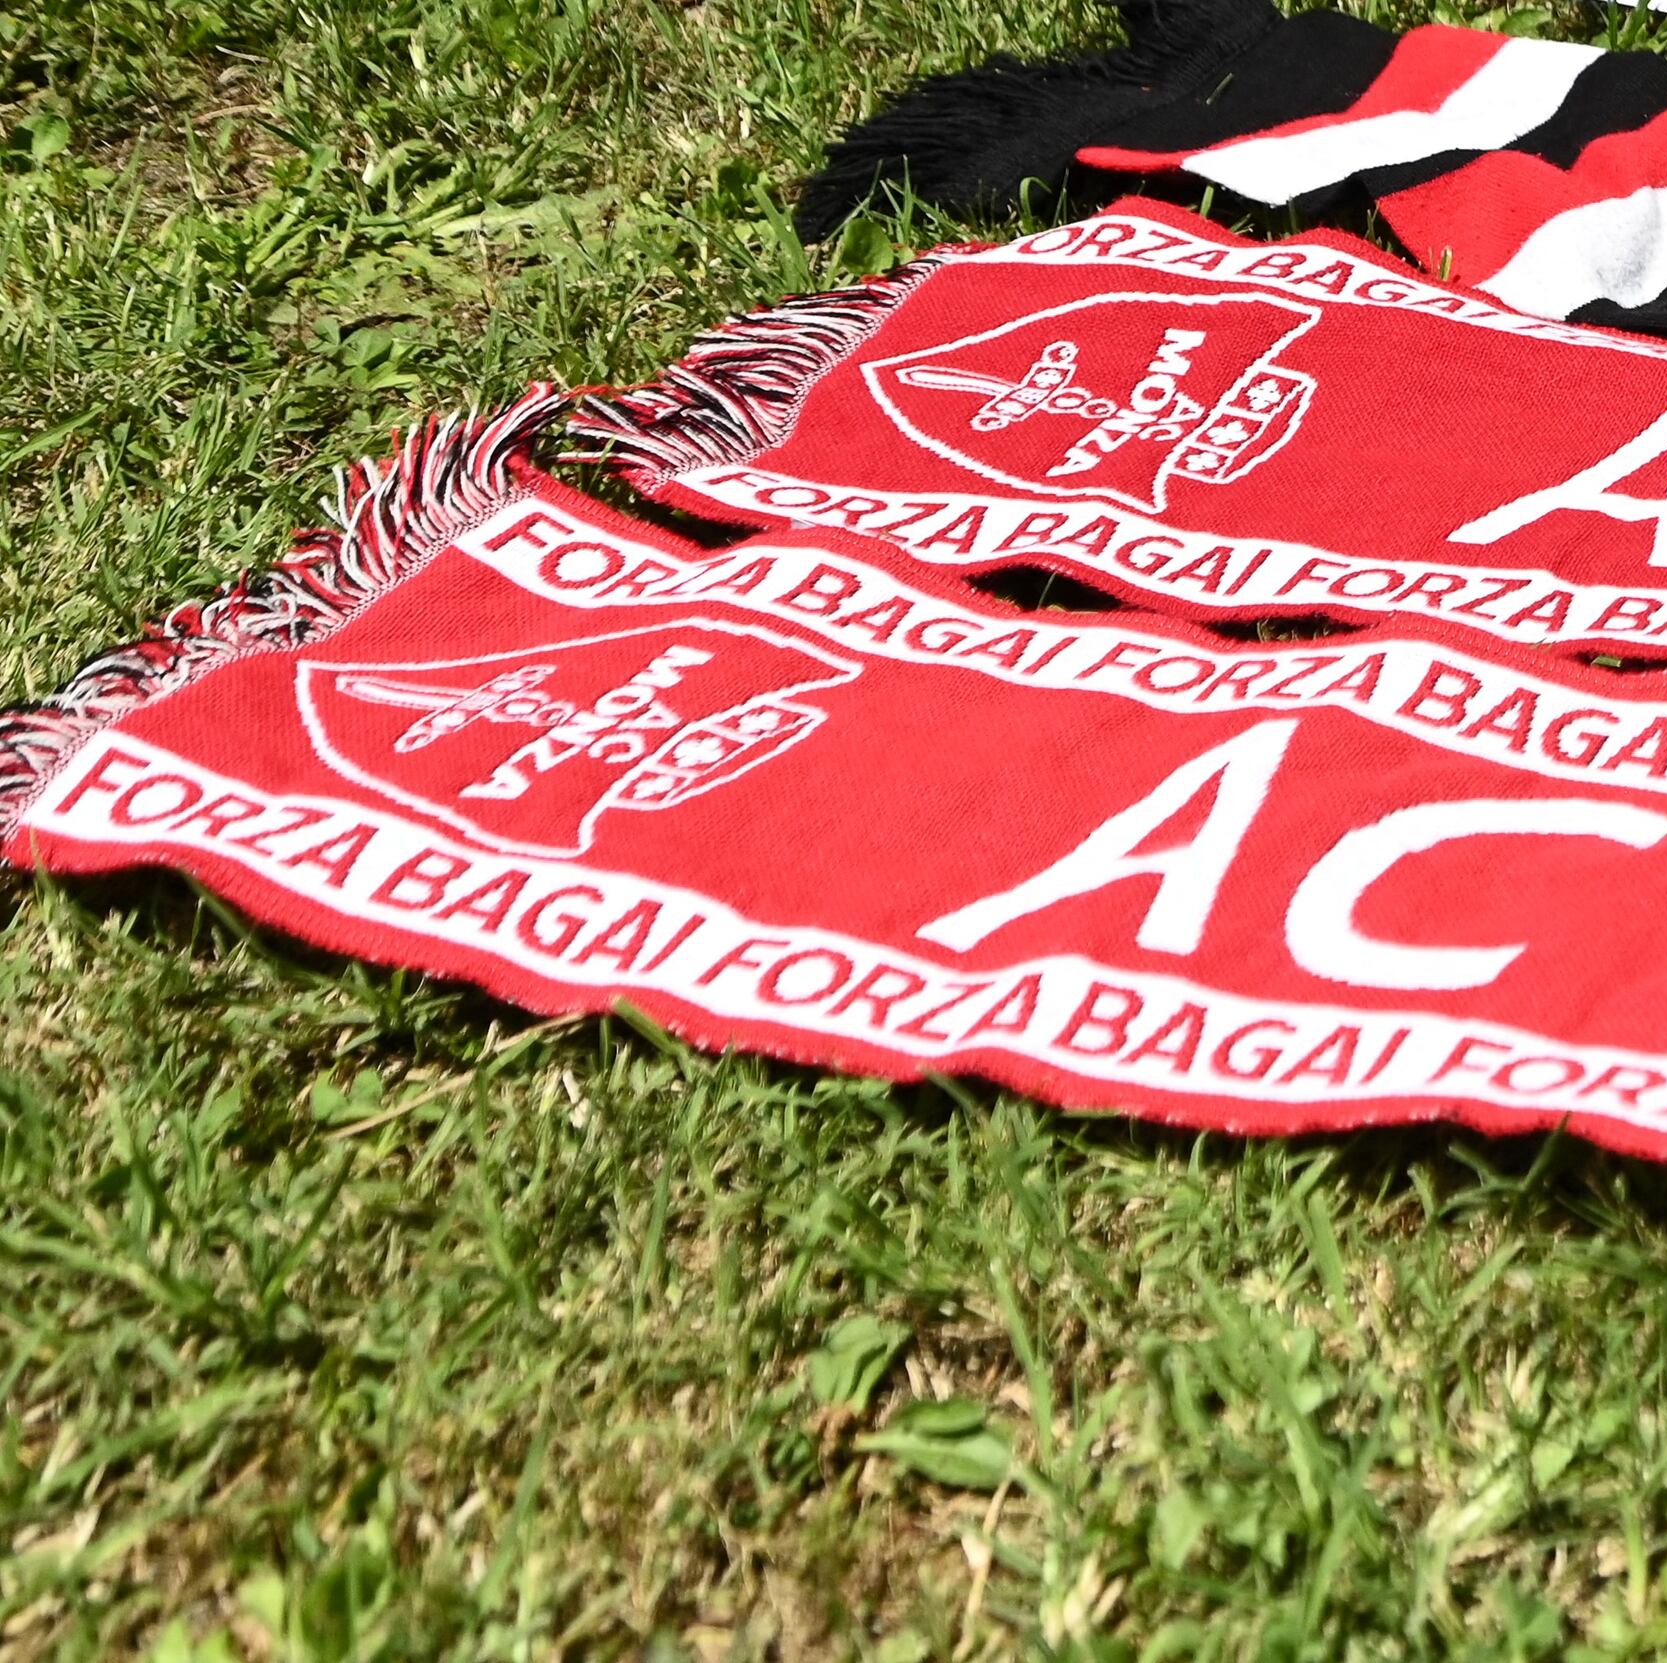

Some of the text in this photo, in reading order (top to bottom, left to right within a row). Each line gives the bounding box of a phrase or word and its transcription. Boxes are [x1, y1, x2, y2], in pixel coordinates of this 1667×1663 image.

[1017, 222, 1500, 320] ORZA BAGAI
[1045, 327, 1206, 478] MONZA
[1137, 390, 1206, 442] AC
[481, 510, 774, 599] FORZA
[771, 563, 1080, 676] BAGAI
[1079, 642, 1389, 703] FORZA
[703, 471, 988, 556] FORZA
[997, 510, 1271, 596] BAGAI
[1272, 558, 1574, 634] FORZA
[458, 644, 717, 801] MONZA
[587, 700, 683, 764] AC
[54, 747, 380, 888] FORZA
[368, 845, 706, 974] BAGAI
[694, 936, 1044, 1042] FORZA
[1050, 979, 1414, 1088] BAGAI
